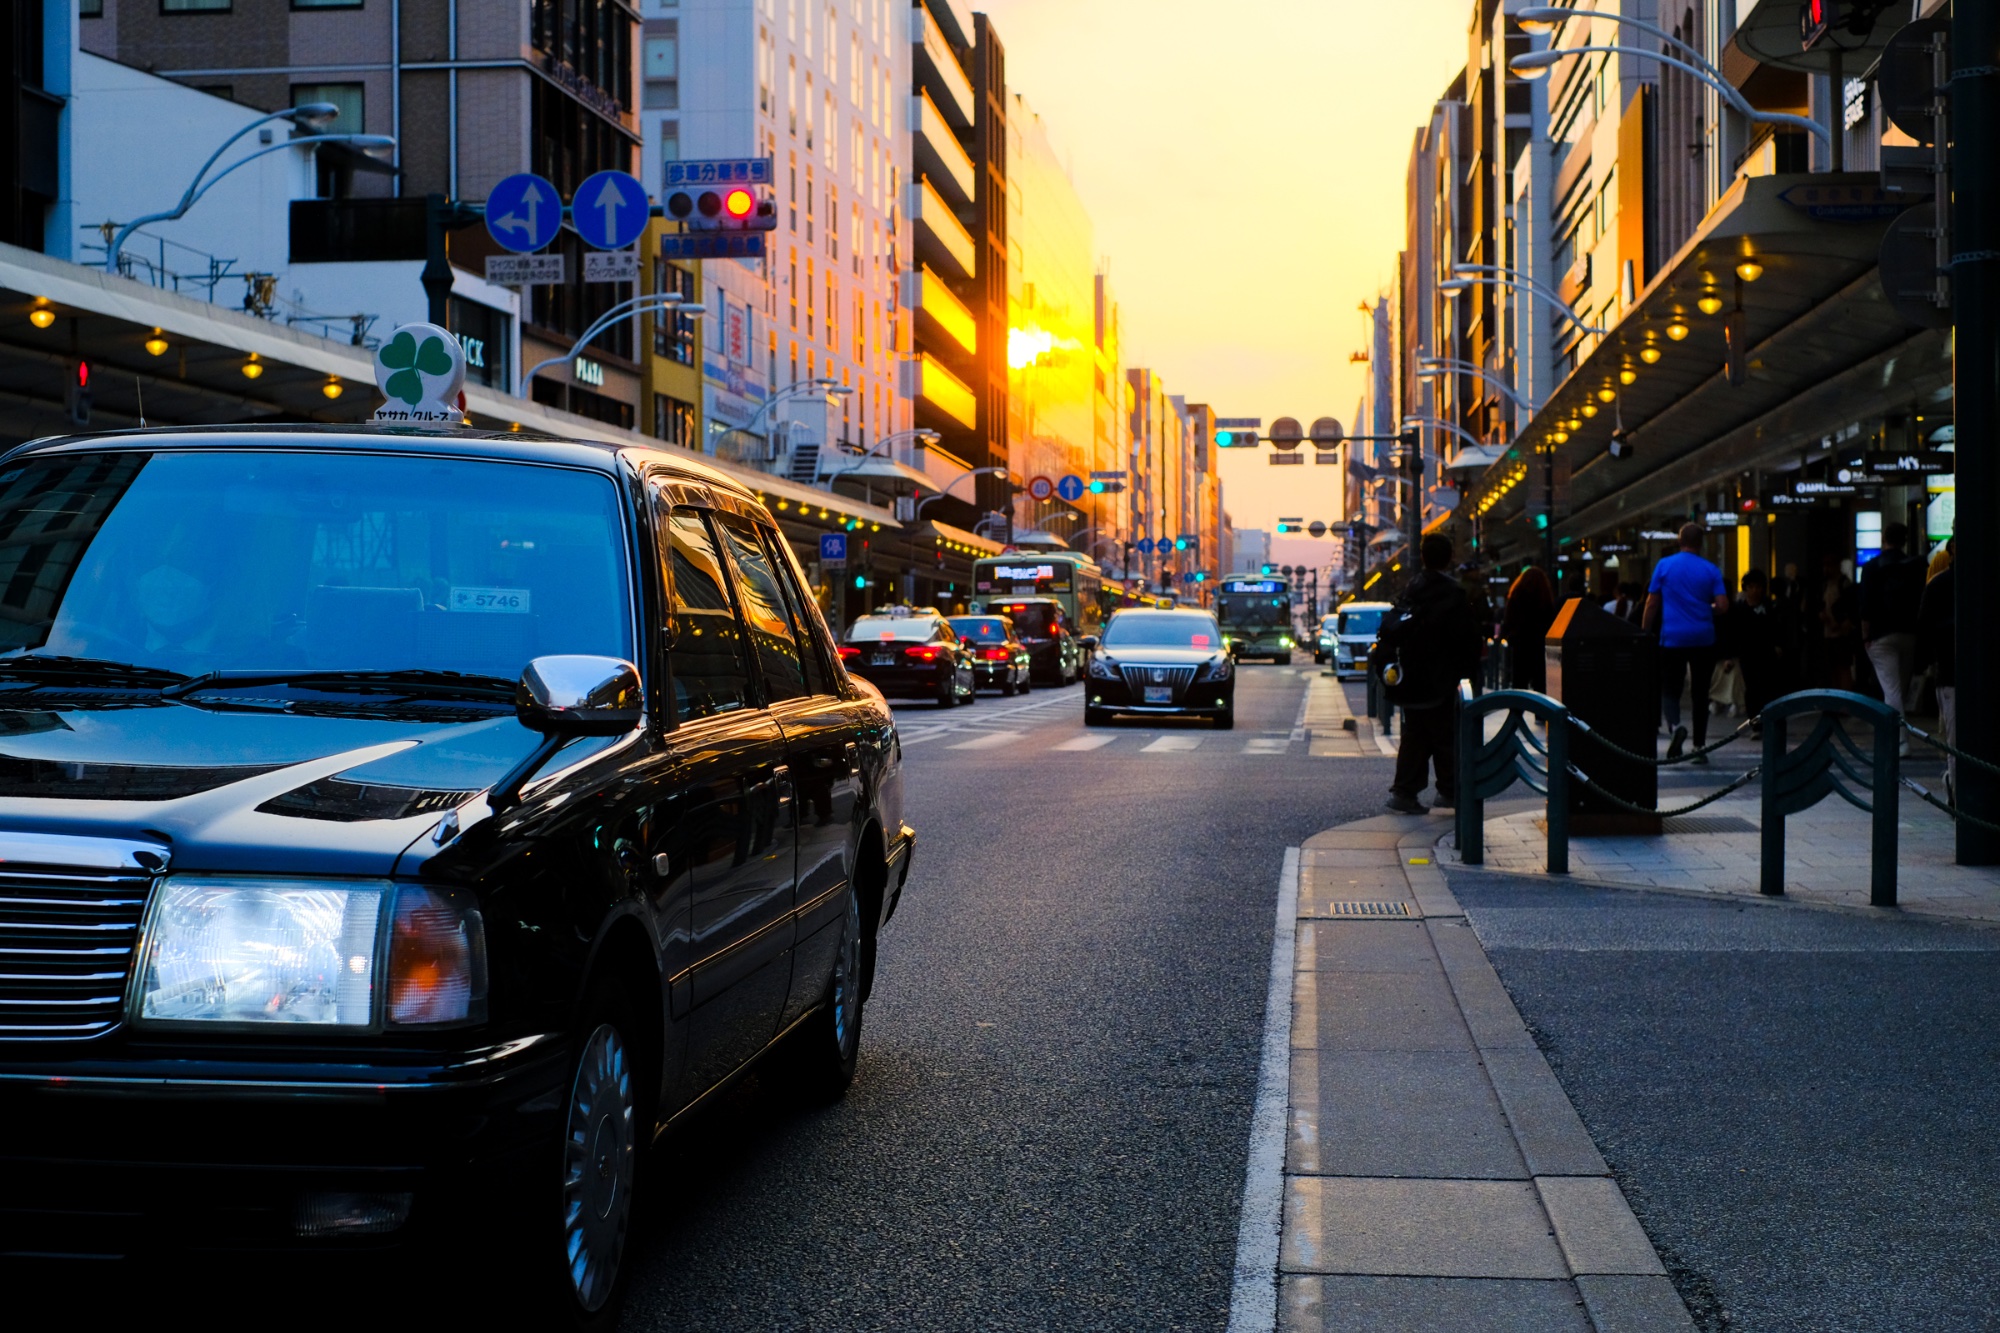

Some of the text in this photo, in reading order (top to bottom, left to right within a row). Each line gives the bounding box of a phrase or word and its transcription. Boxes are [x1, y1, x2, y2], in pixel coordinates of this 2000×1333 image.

[455, 333, 485, 368] ICK
[576, 356, 604, 387] PLAZA
[1034, 482, 1049, 495] 40
[475, 595, 520, 608] 5746
